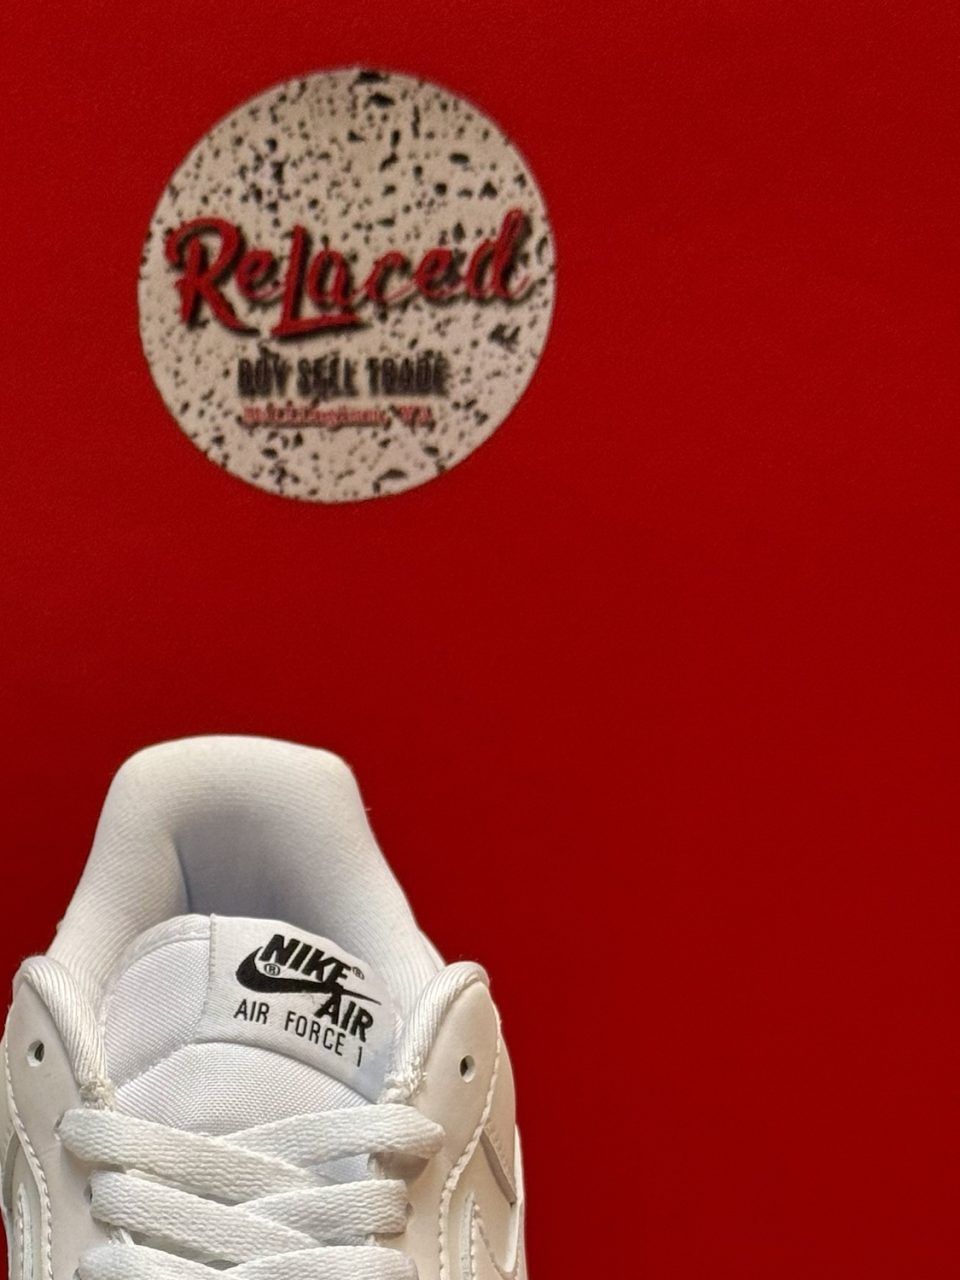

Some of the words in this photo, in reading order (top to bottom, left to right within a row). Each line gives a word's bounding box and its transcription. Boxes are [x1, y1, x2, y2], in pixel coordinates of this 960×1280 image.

[164, 207, 544, 340] ReLaced
[296, 356, 359, 398] SELL
[365, 355, 451, 398] TRADE
[258, 934, 352, 985] NIKE
[233, 998, 270, 1025] AIR
[284, 1010, 346, 1056] FORCE
[356, 1046, 363, 1067] 1
[314, 985, 374, 1043] AIR
